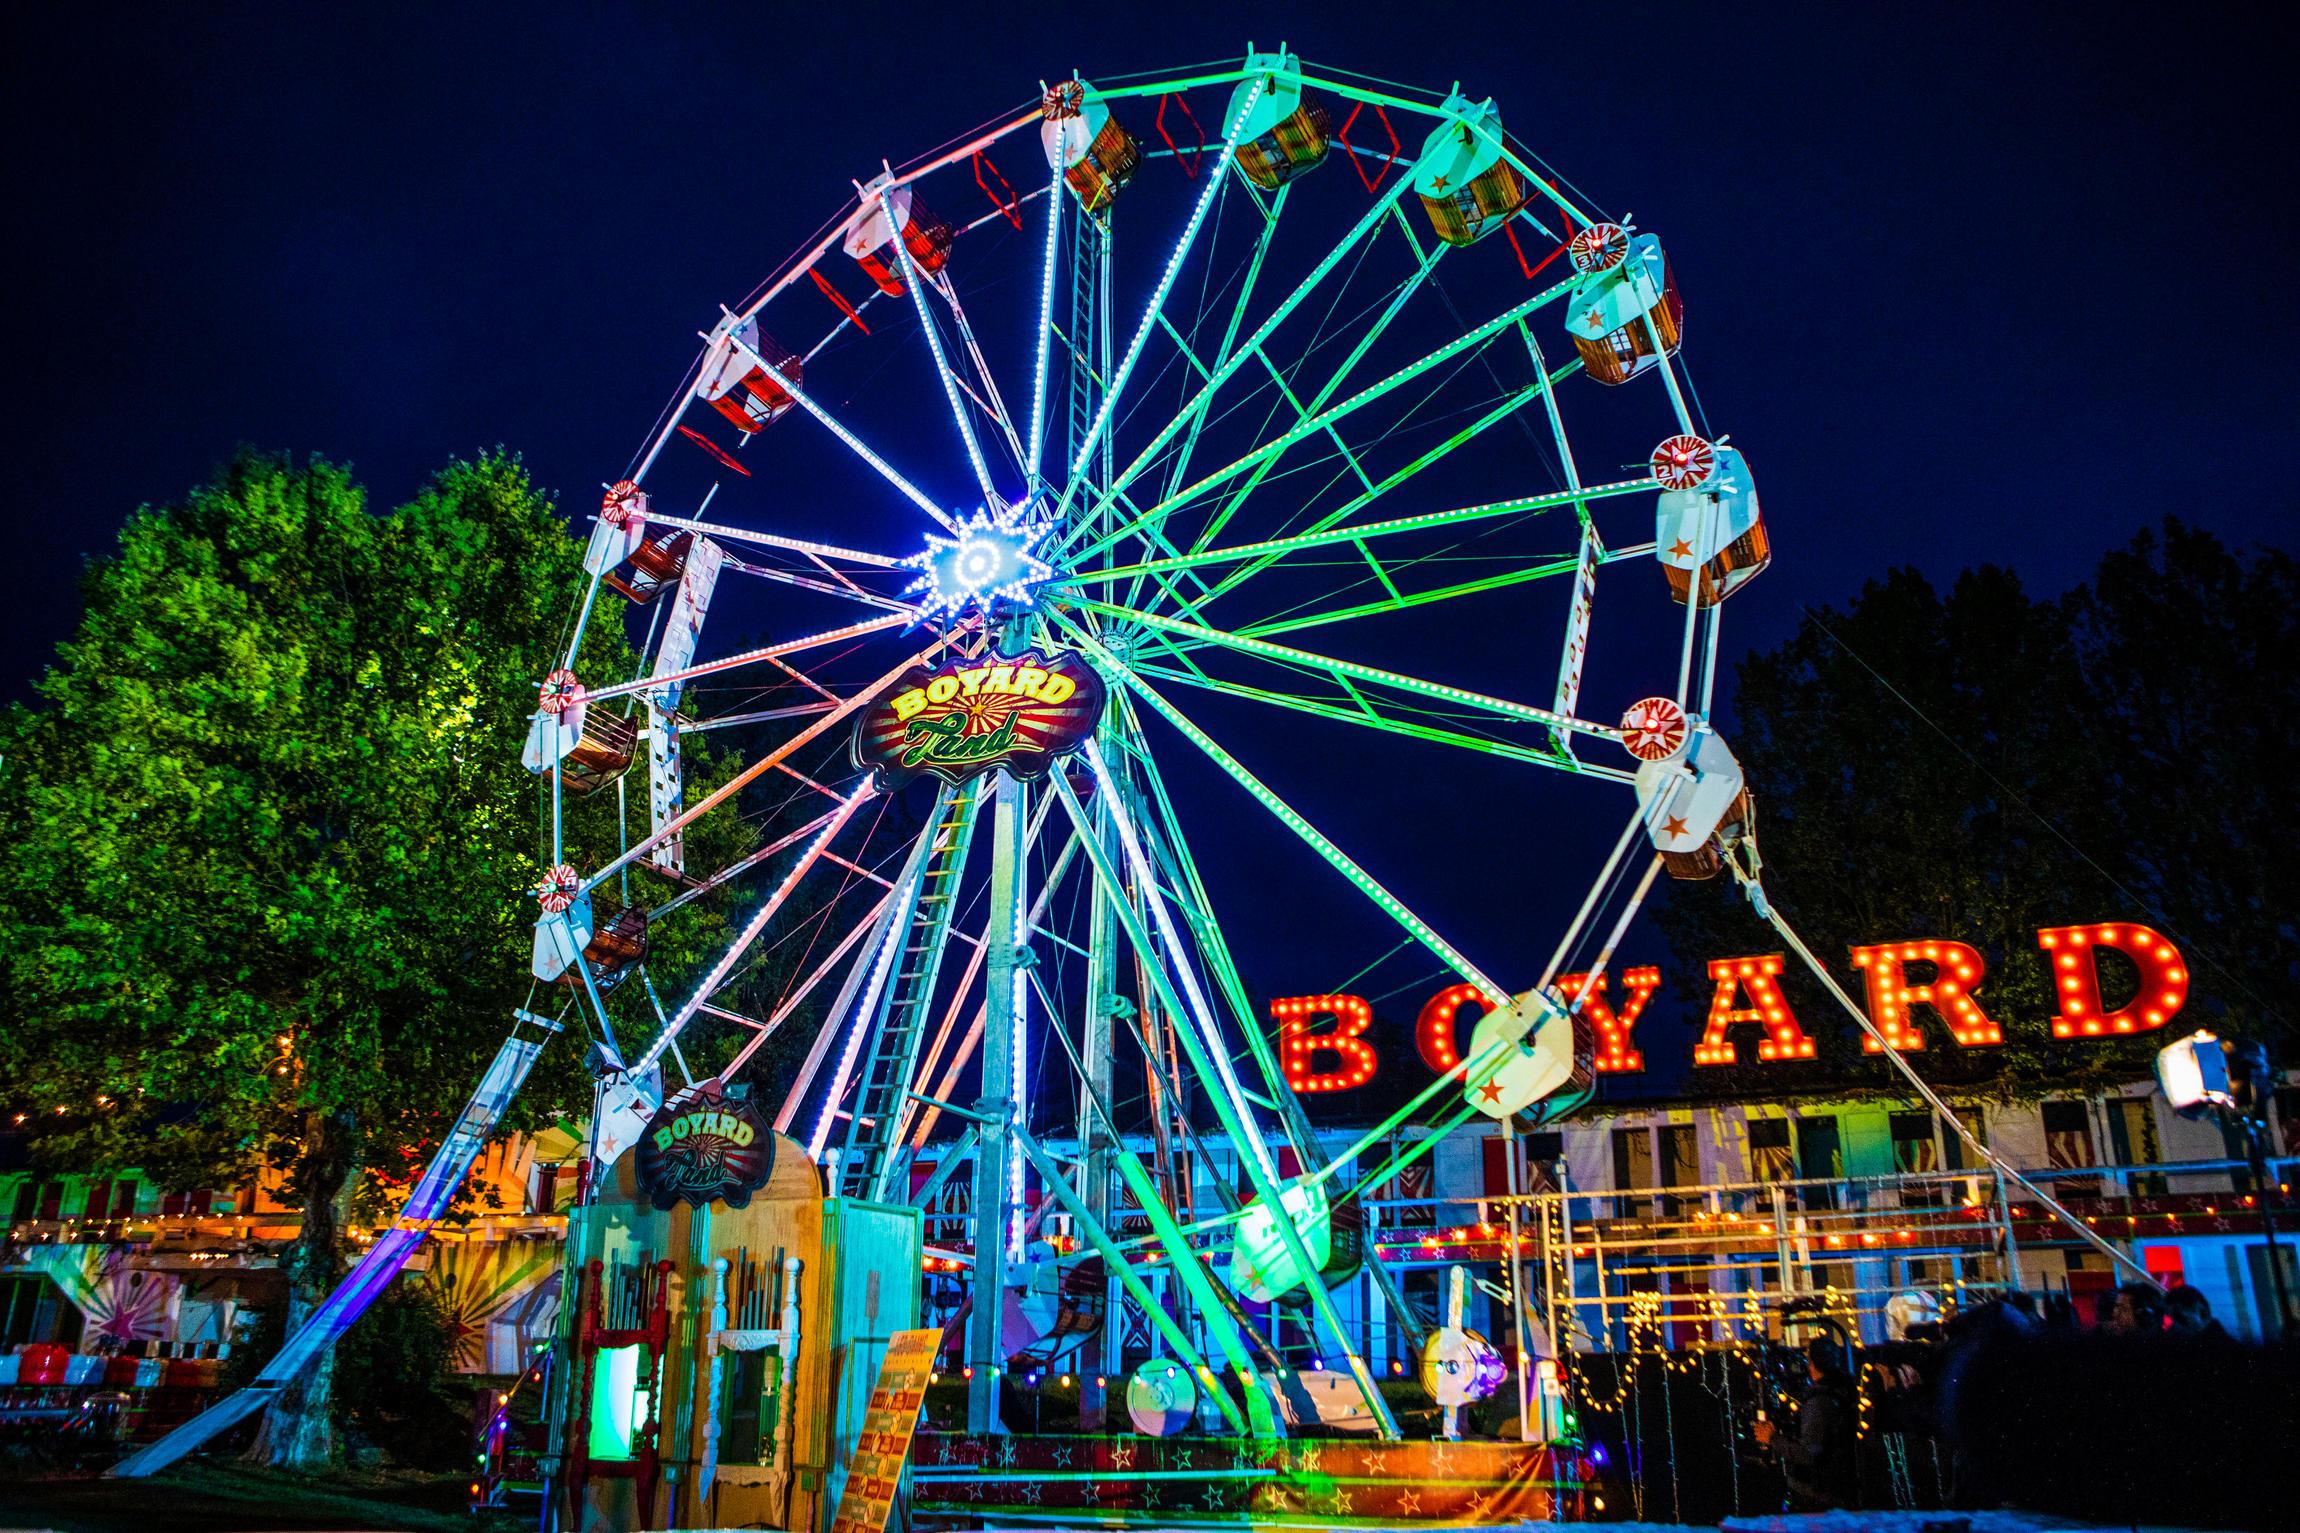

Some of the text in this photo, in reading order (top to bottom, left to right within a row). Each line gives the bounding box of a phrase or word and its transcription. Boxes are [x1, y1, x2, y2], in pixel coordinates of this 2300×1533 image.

[1657, 464, 1671, 478] 2
[889, 666, 1077, 722] BOYARD
[902, 710, 1045, 768] Land
[652, 1111, 755, 1152] BOYARD
[664, 1149, 743, 1191] Land
